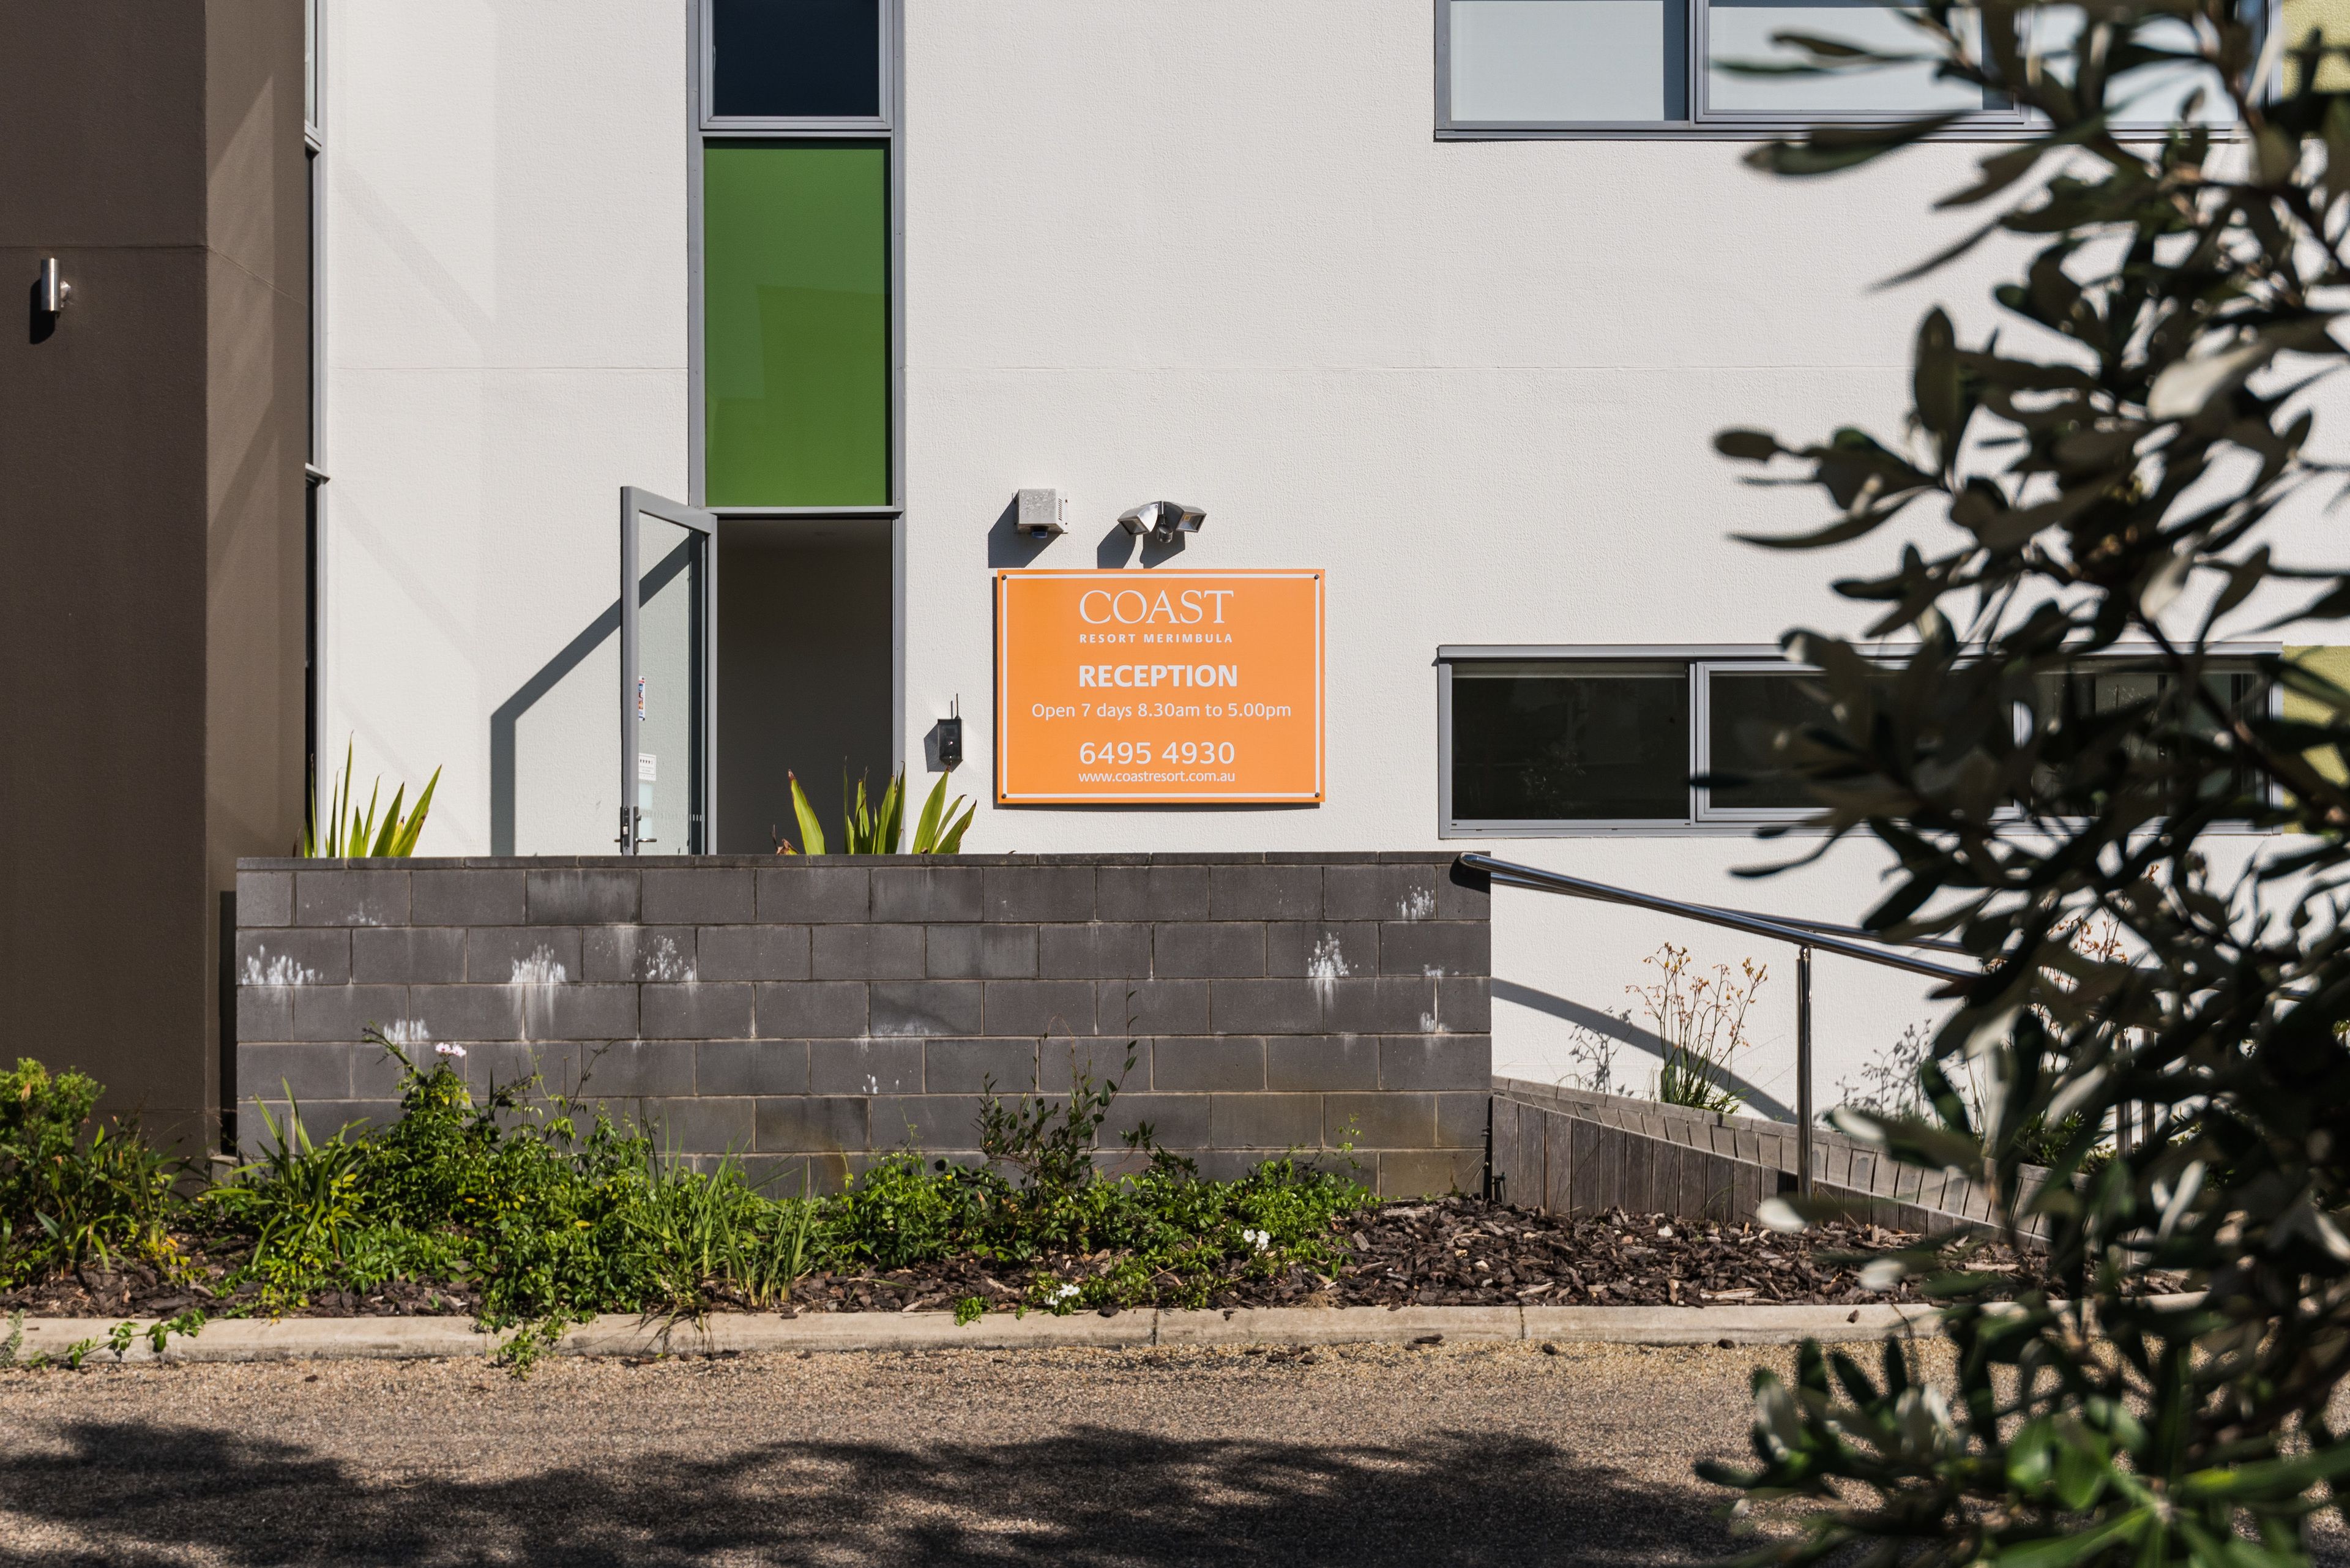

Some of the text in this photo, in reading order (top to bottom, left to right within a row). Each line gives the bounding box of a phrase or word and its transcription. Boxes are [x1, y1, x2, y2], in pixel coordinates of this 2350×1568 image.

[1079, 589, 1234, 624] COAST
[1080, 633, 1233, 643] RESORT MERIMBULA
[1079, 664, 1237, 687] RECEPTION
[1032, 703, 1291, 721] Open 7 days 8.30am to 5.00pm
[1080, 742, 1235, 764] 6495 4930
[1078, 771, 1235, 782] www.coastresort.com.au
